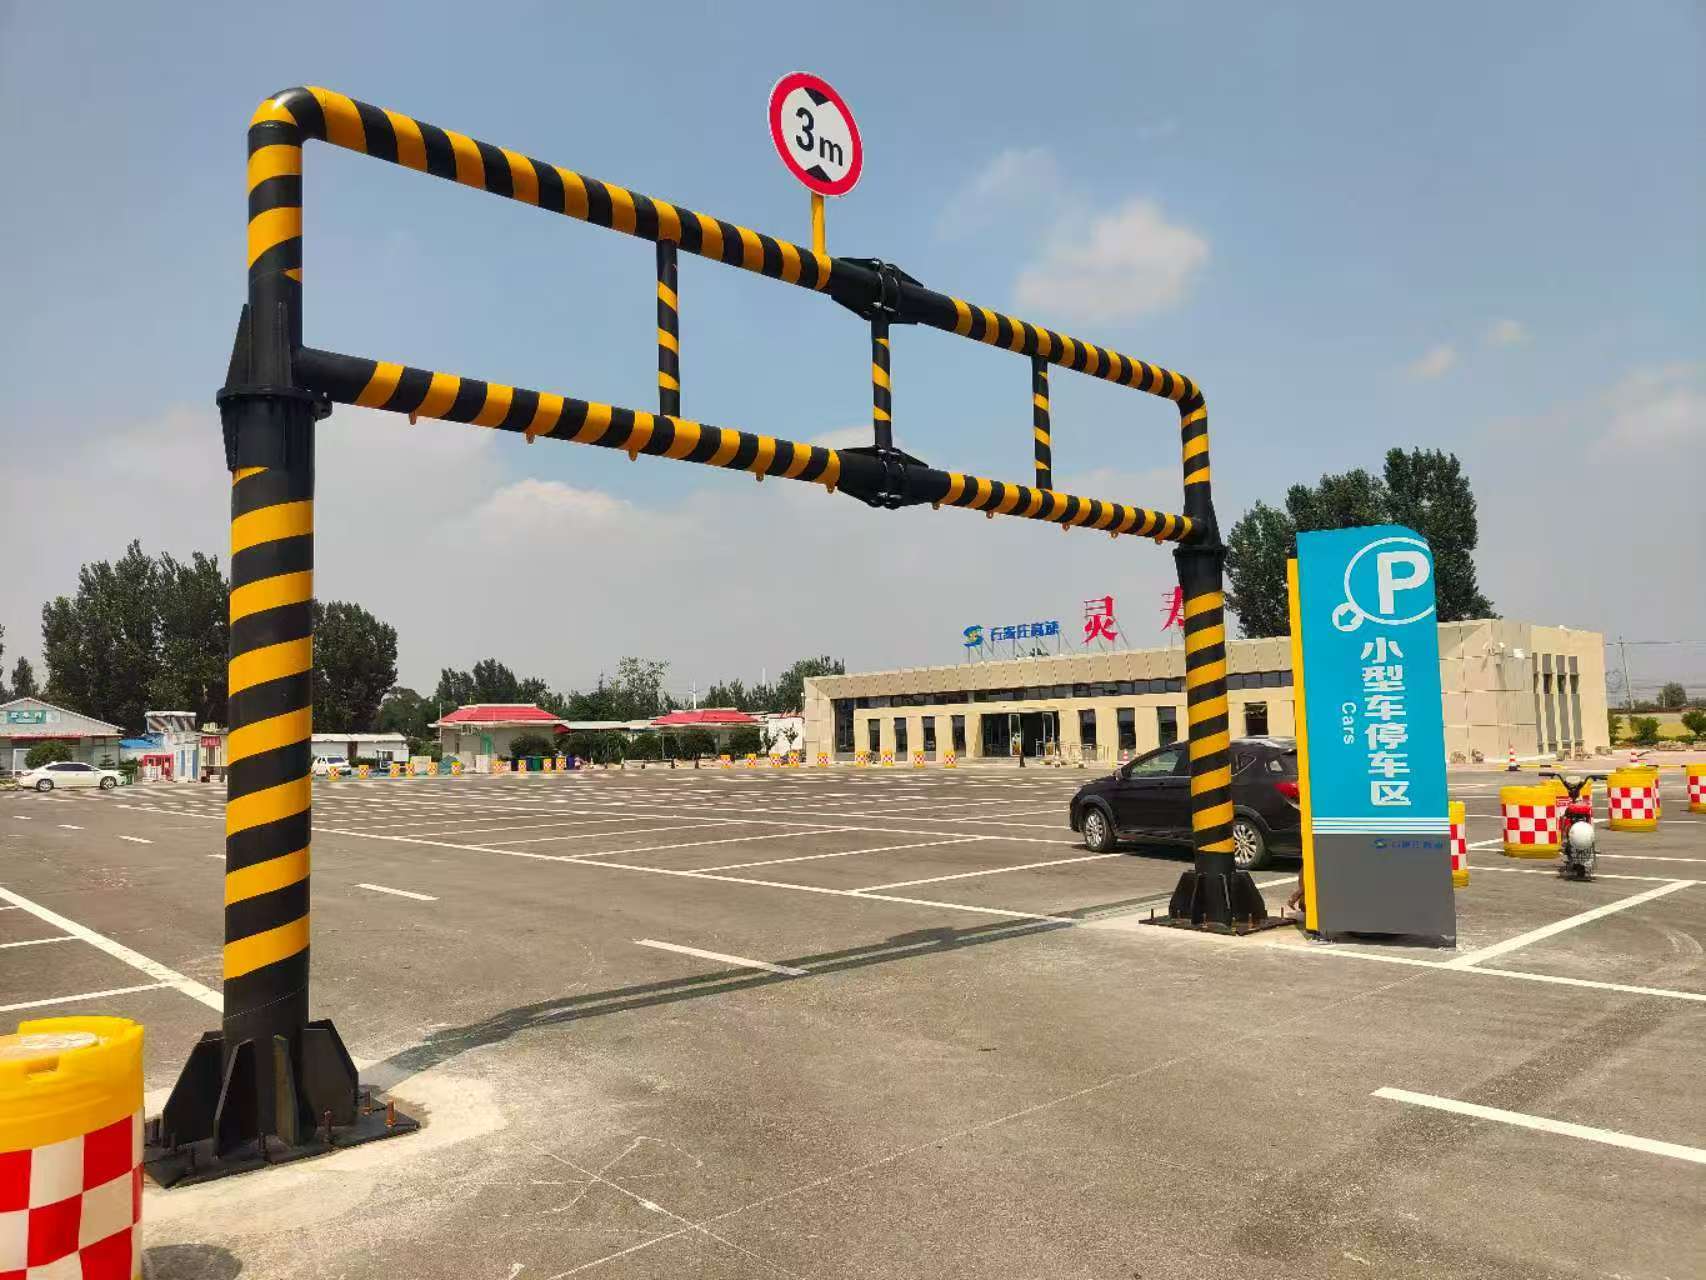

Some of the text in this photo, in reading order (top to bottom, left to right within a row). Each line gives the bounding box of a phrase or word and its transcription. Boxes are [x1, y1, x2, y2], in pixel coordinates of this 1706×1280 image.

[1376, 550, 1431, 615] P
[1341, 702, 1356, 745] Cars
[1360, 637, 1413, 807] 小型车停车区
